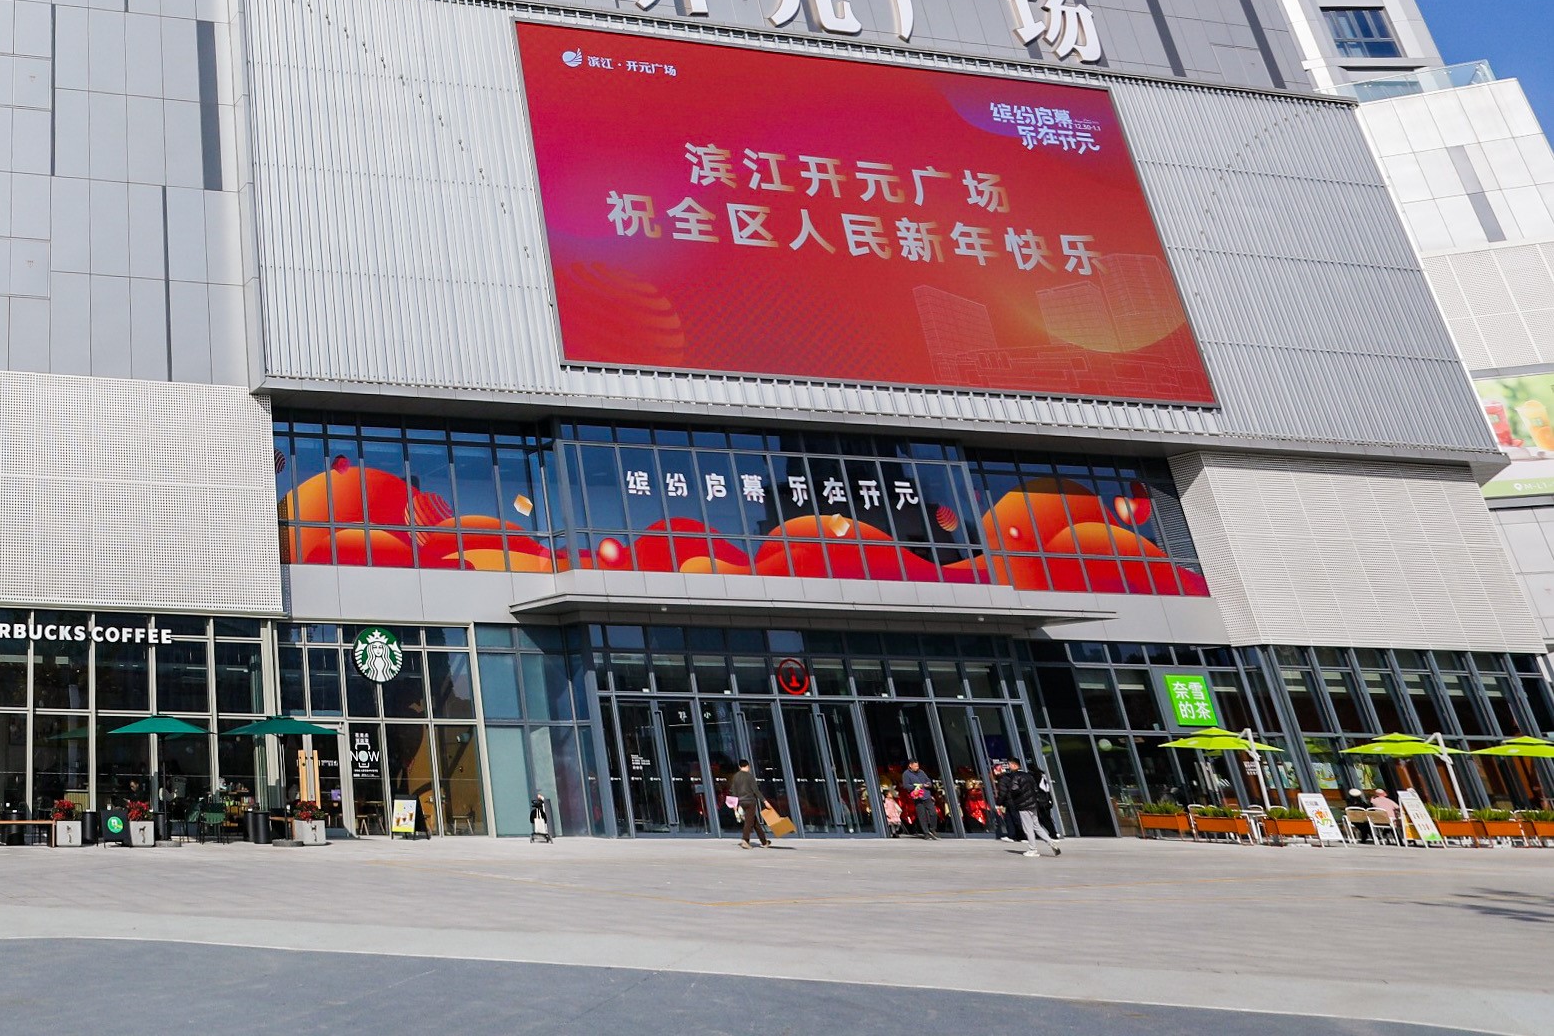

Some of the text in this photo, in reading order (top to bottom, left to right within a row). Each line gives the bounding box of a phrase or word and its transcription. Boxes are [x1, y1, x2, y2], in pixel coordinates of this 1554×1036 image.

[989, 102, 1073, 129] 缤纷启幕
[1017, 125, 1101, 154] 乐在开元
[684, 141, 1011, 214] 滨江开元广场
[606, 190, 1106, 277] 祝全区人民新年快乐
[626, 470, 920, 511] 缤纷启幕 乐在开元
[90, 625, 172, 644] COFFEE
[1171, 681, 1205, 700] 奈雪
[1178, 701, 1212, 720] 的茶
